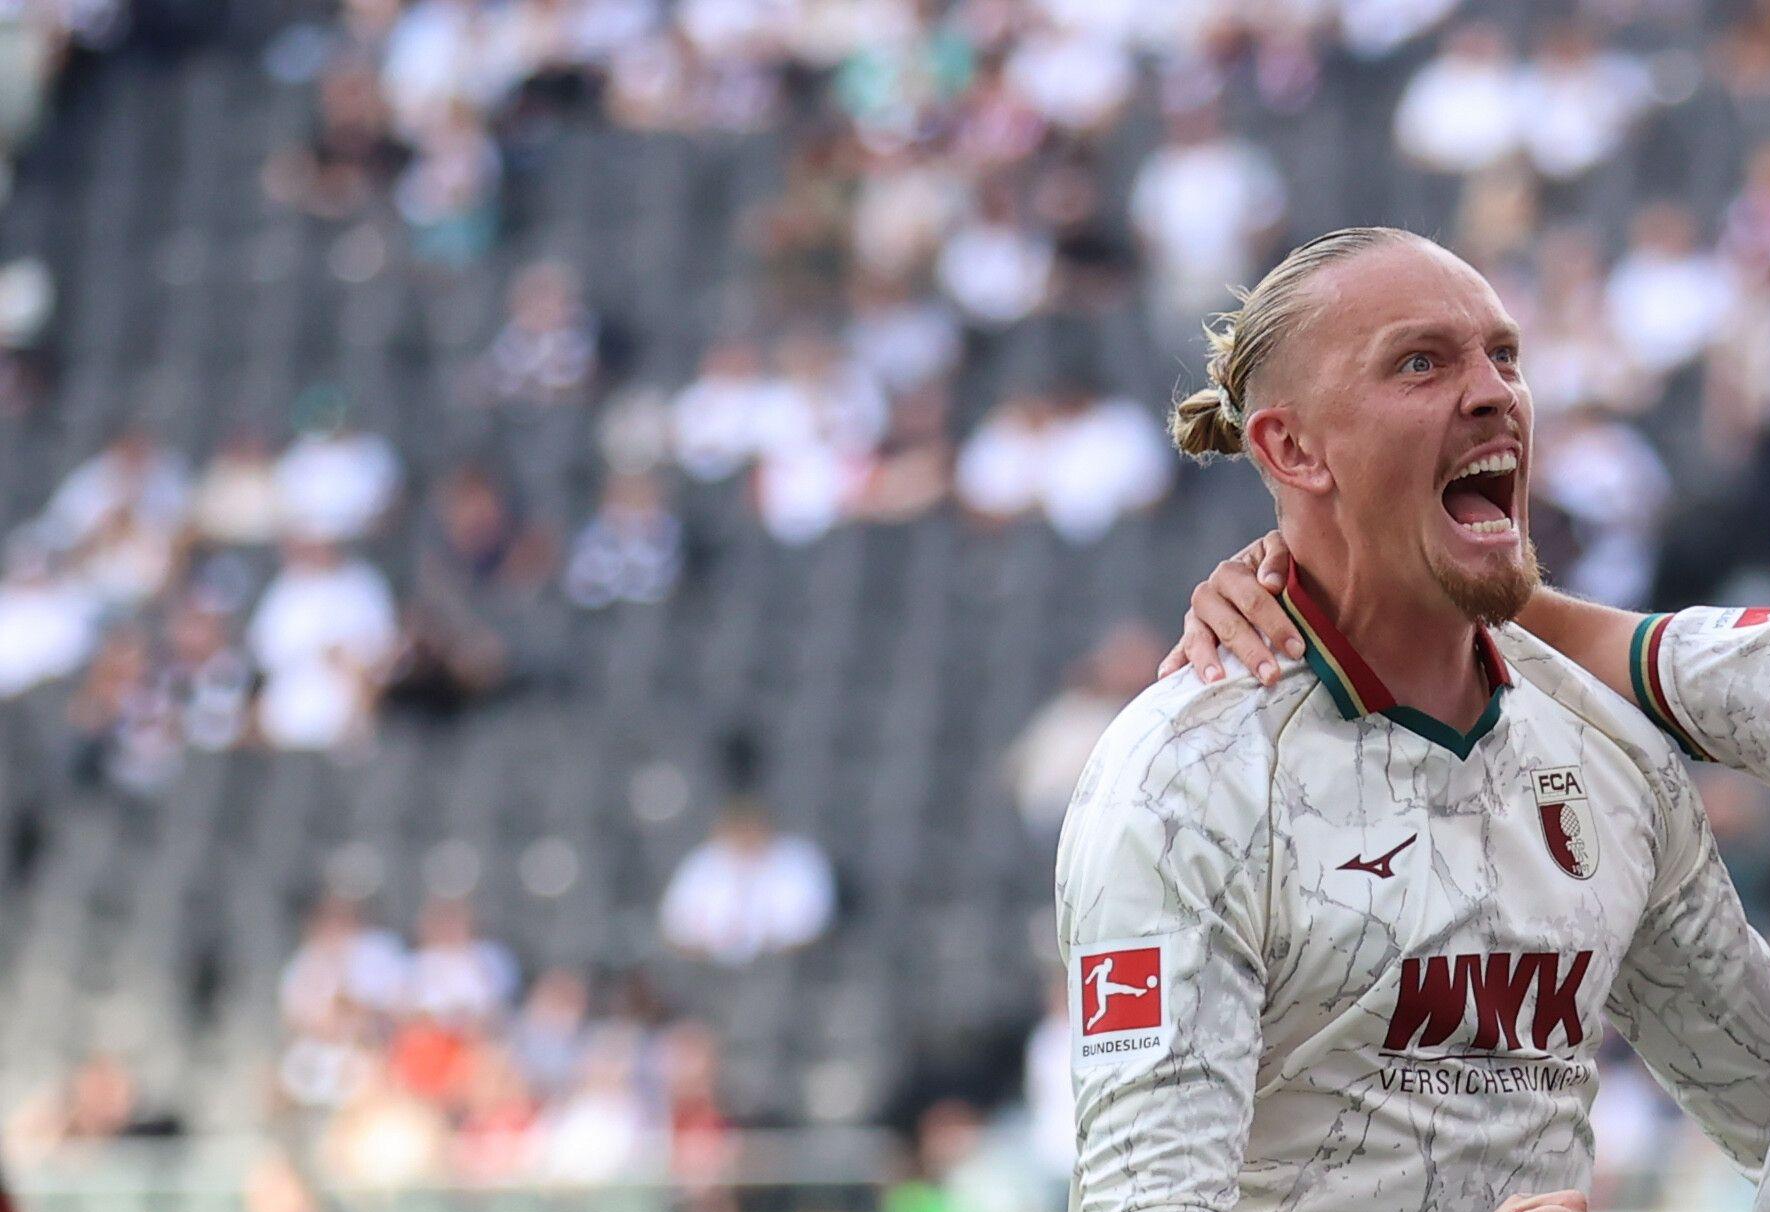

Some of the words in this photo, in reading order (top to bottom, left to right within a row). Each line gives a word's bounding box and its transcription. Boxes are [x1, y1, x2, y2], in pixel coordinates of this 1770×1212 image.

[1538, 771, 1582, 795] FCA
[1382, 950, 1594, 1051] WWK
[1082, 1035, 1161, 1058] BUNDESLIGA
[1378, 1063, 1593, 1096] VERSICHERUNGEN
